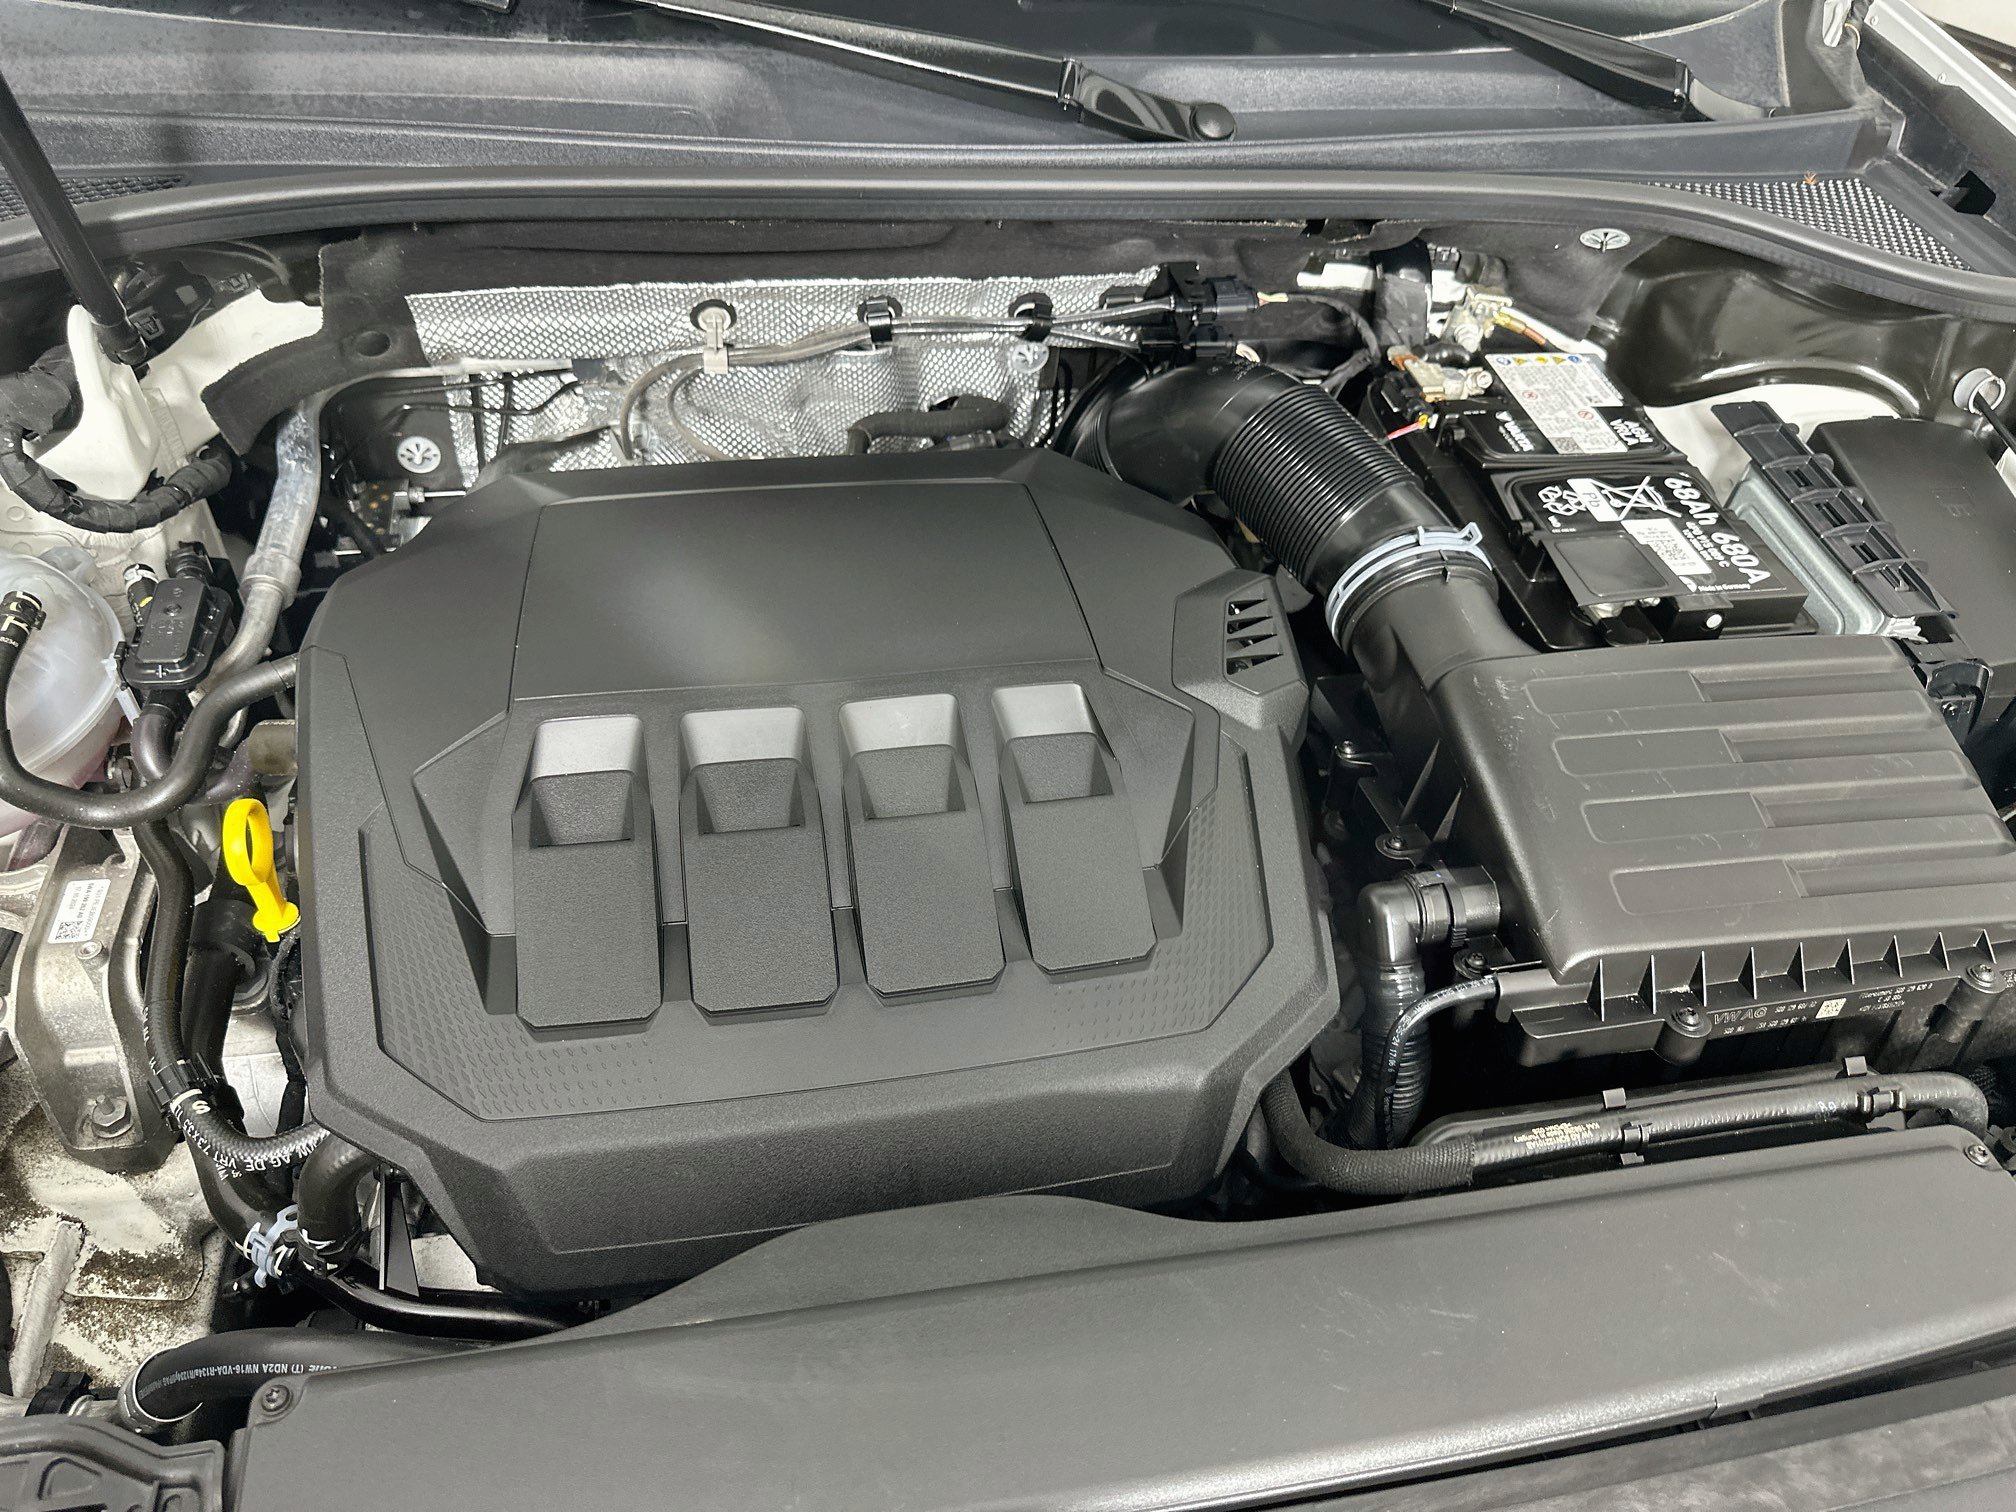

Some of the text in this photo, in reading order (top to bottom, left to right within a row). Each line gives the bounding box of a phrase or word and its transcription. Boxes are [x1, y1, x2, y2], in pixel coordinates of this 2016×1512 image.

[1504, 420, 1535, 452] VARTA
[1610, 418, 1640, 446] VRLA
[1624, 420, 1654, 443] AGM
[1664, 477, 1720, 526] 68Ah
[1711, 532, 1771, 585] 680A
[1722, 583, 1751, 591] Germany
[1714, 1010, 1743, 1025] VW
[191, 1100, 211, 1115] S
[263, 1363, 289, 1374] ND2A
